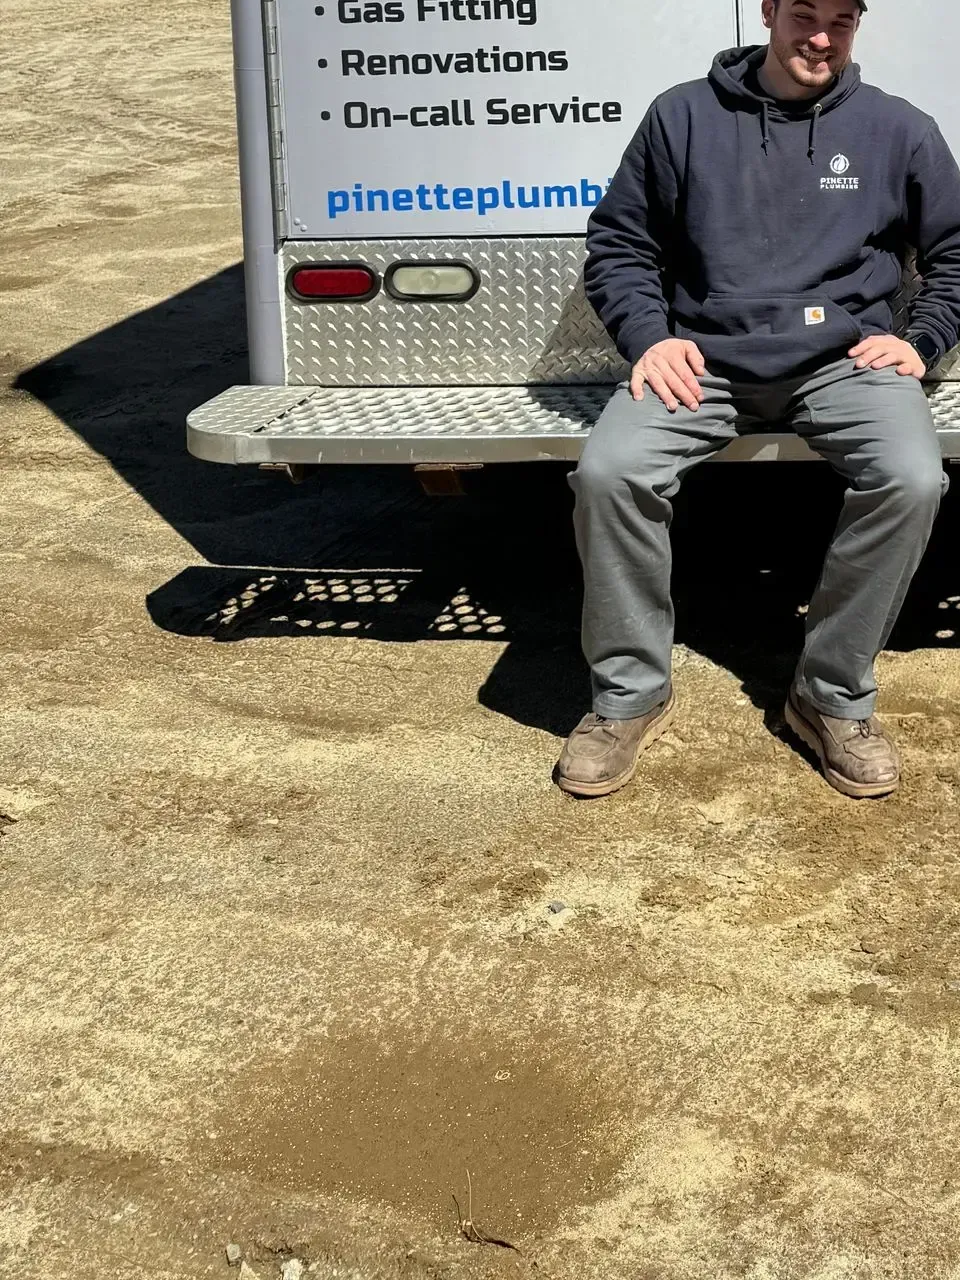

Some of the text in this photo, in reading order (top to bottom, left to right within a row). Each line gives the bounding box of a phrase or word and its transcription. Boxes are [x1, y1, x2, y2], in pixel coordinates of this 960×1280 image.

[342, 46, 568, 75] Renovations
[344, 97, 621, 128] On-call Service
